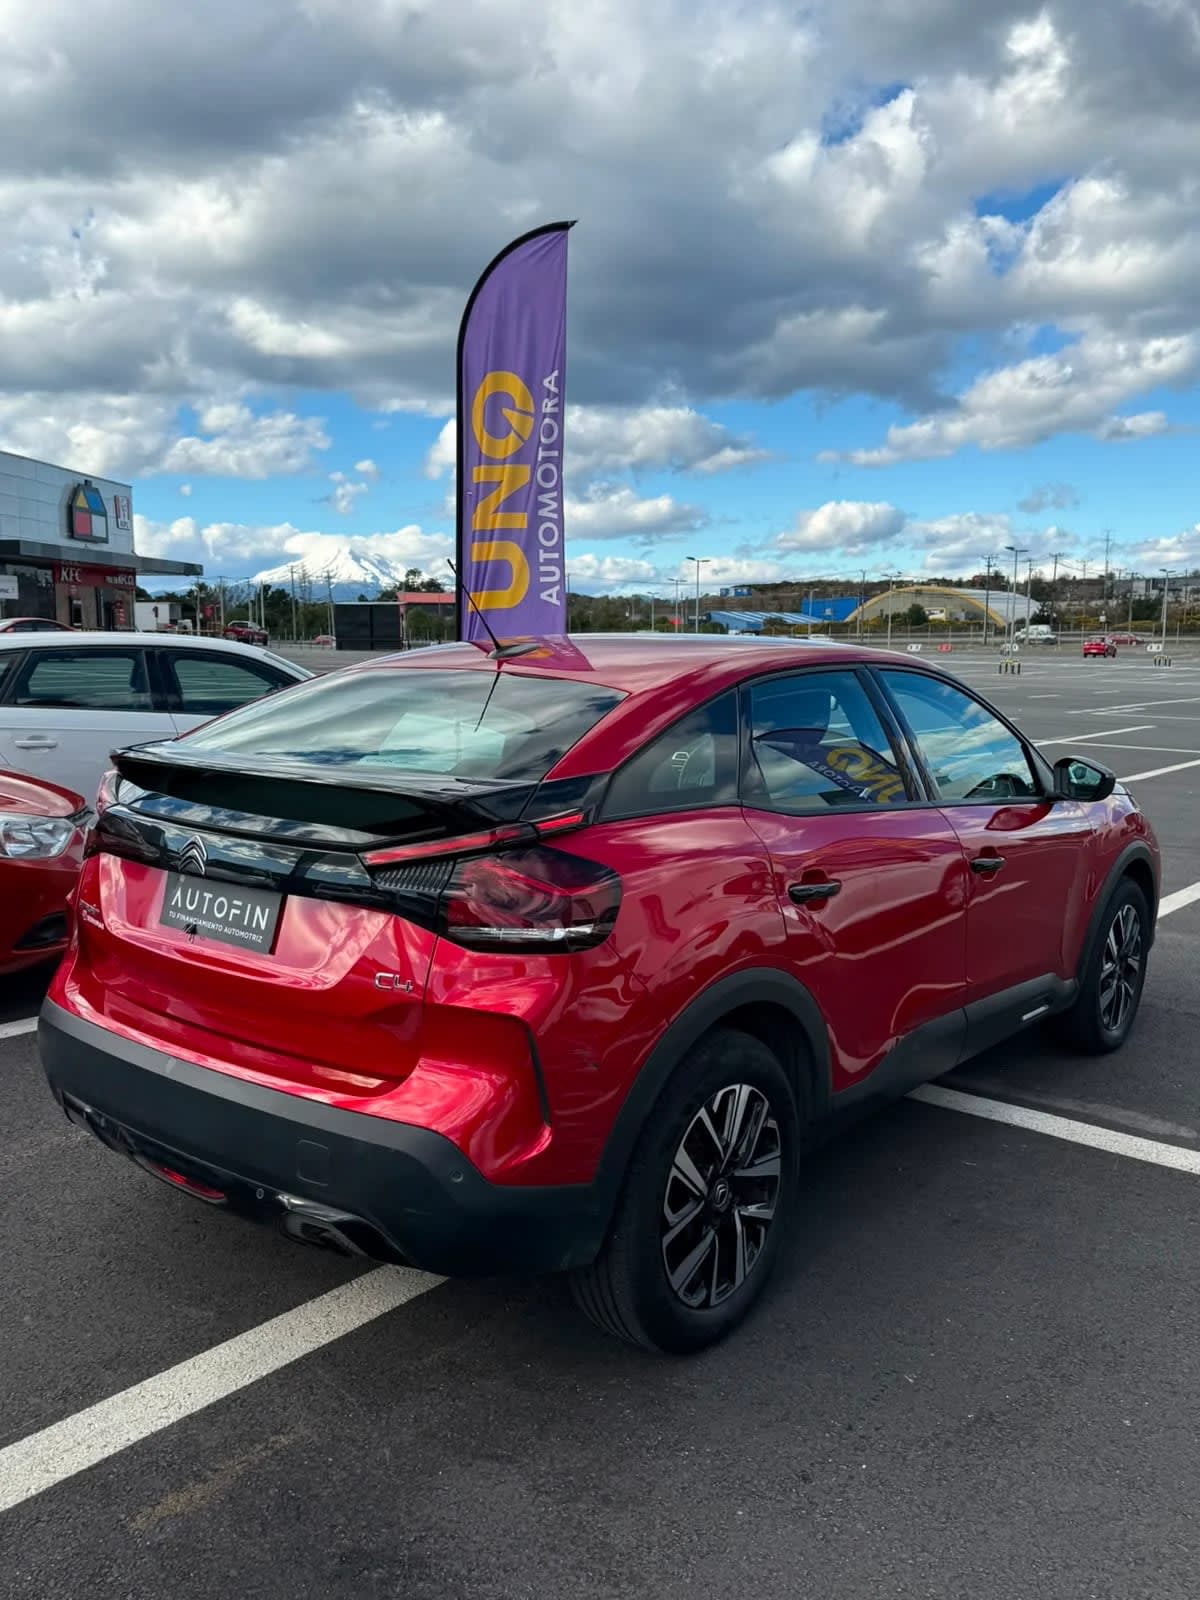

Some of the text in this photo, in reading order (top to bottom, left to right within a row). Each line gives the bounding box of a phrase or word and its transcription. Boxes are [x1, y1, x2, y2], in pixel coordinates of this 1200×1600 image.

[536, 369, 560, 606] AUTOMOTORA
[61, 567, 82, 583] KFC
[171, 887, 269, 931] AUTOFIN
[169, 910, 263, 943] TU FINANCIAMIENTO AUTOMOTRIZ
[375, 972, 413, 992] C4
